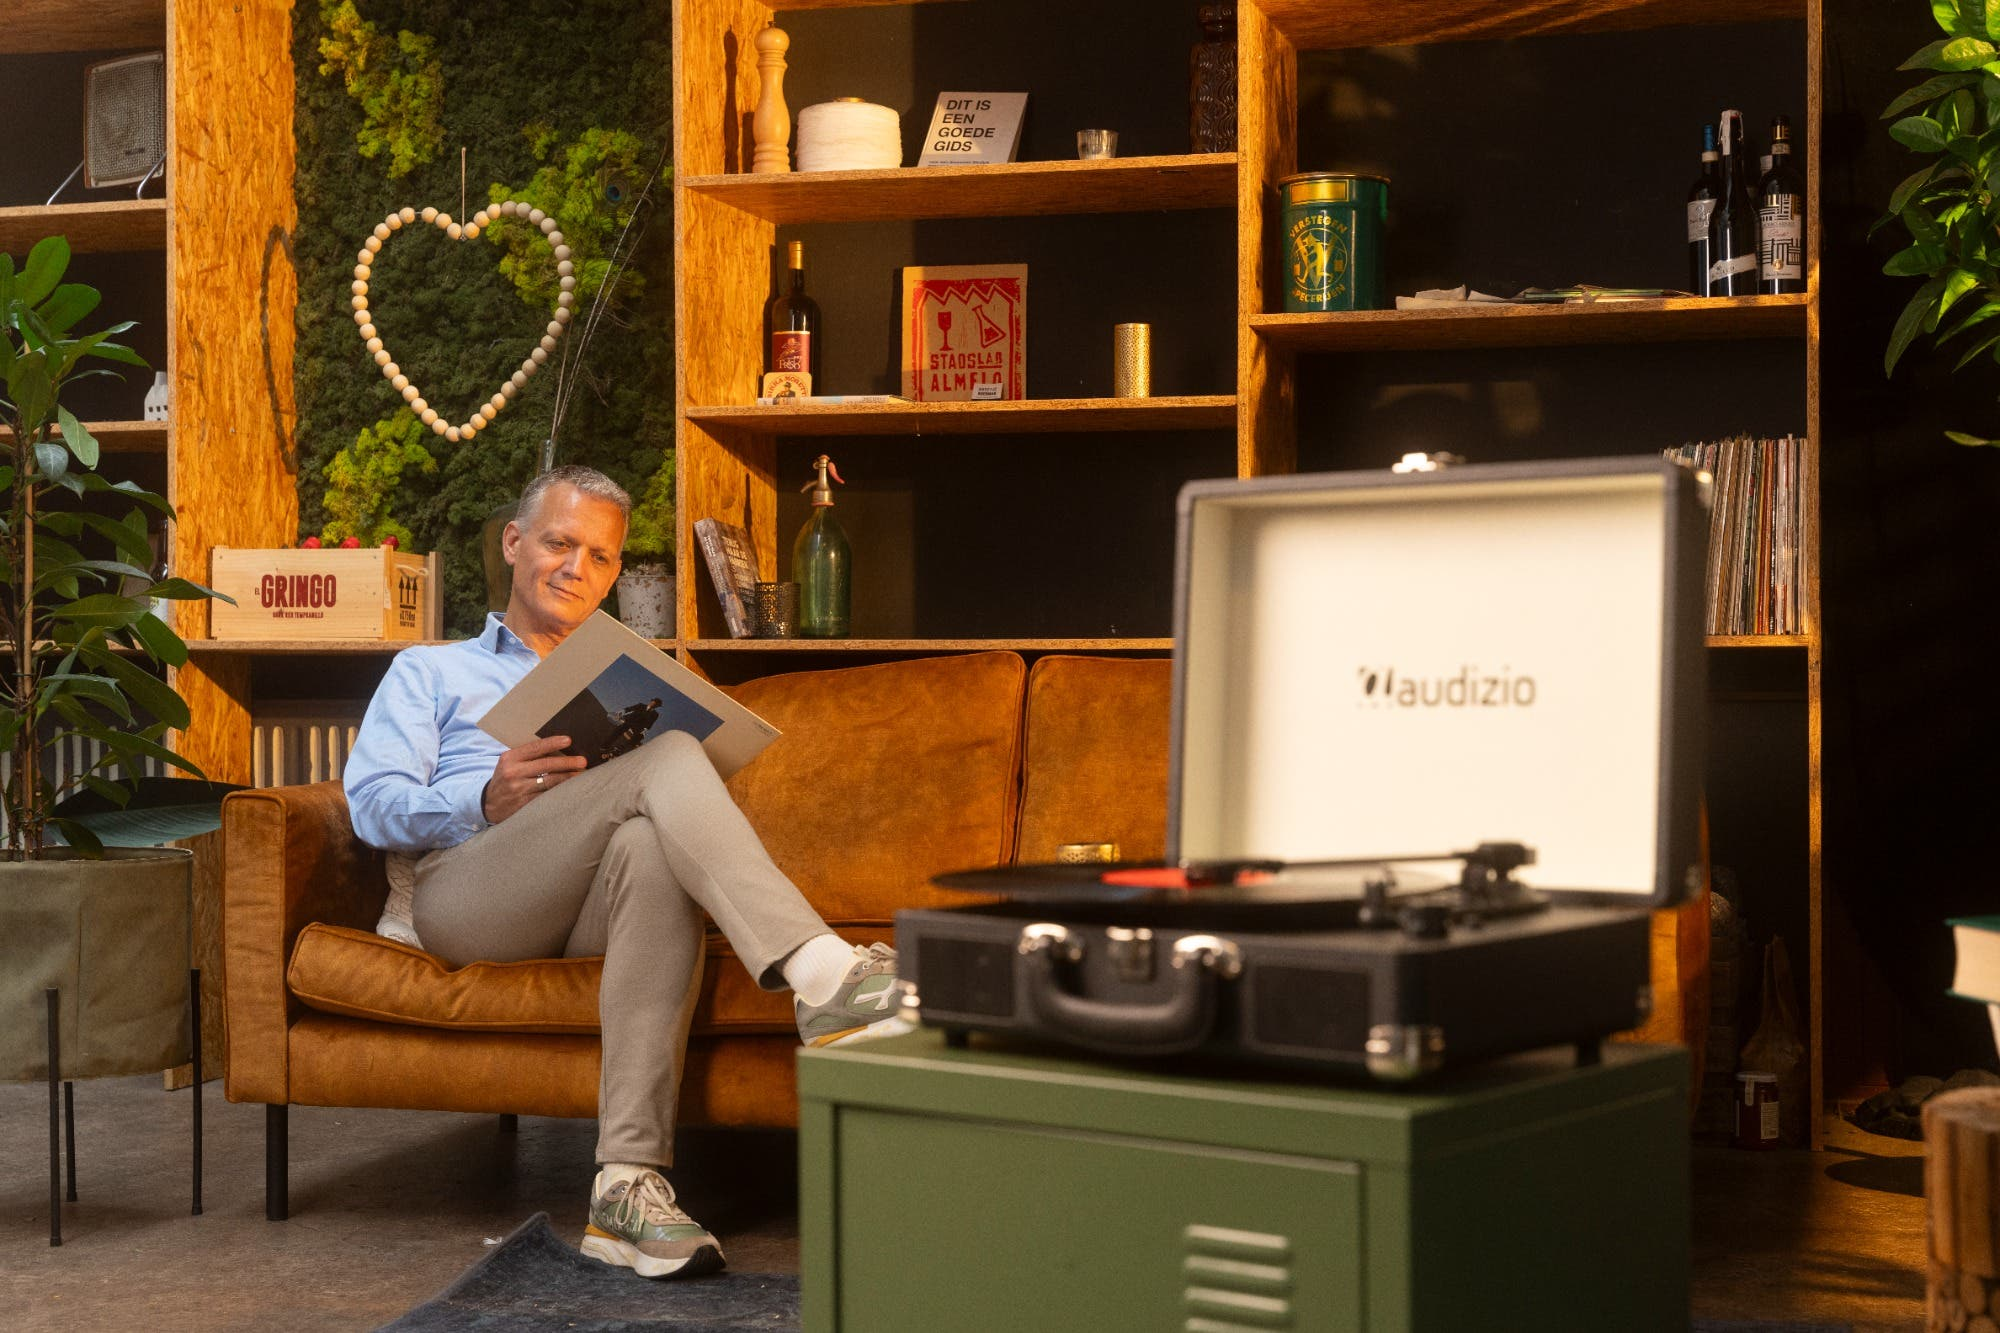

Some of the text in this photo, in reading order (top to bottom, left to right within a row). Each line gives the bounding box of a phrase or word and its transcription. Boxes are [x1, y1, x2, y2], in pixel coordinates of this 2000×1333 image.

[946, 100, 992, 110] DIT IS
[942, 113, 975, 124] EEN
[938, 127, 996, 138] GOEDE
[933, 141, 973, 152] GIDS
[1289, 215, 1348, 238] VERSTEGEN
[261, 574, 337, 609] GRINGO
[1399, 666, 1536, 707] audizio
